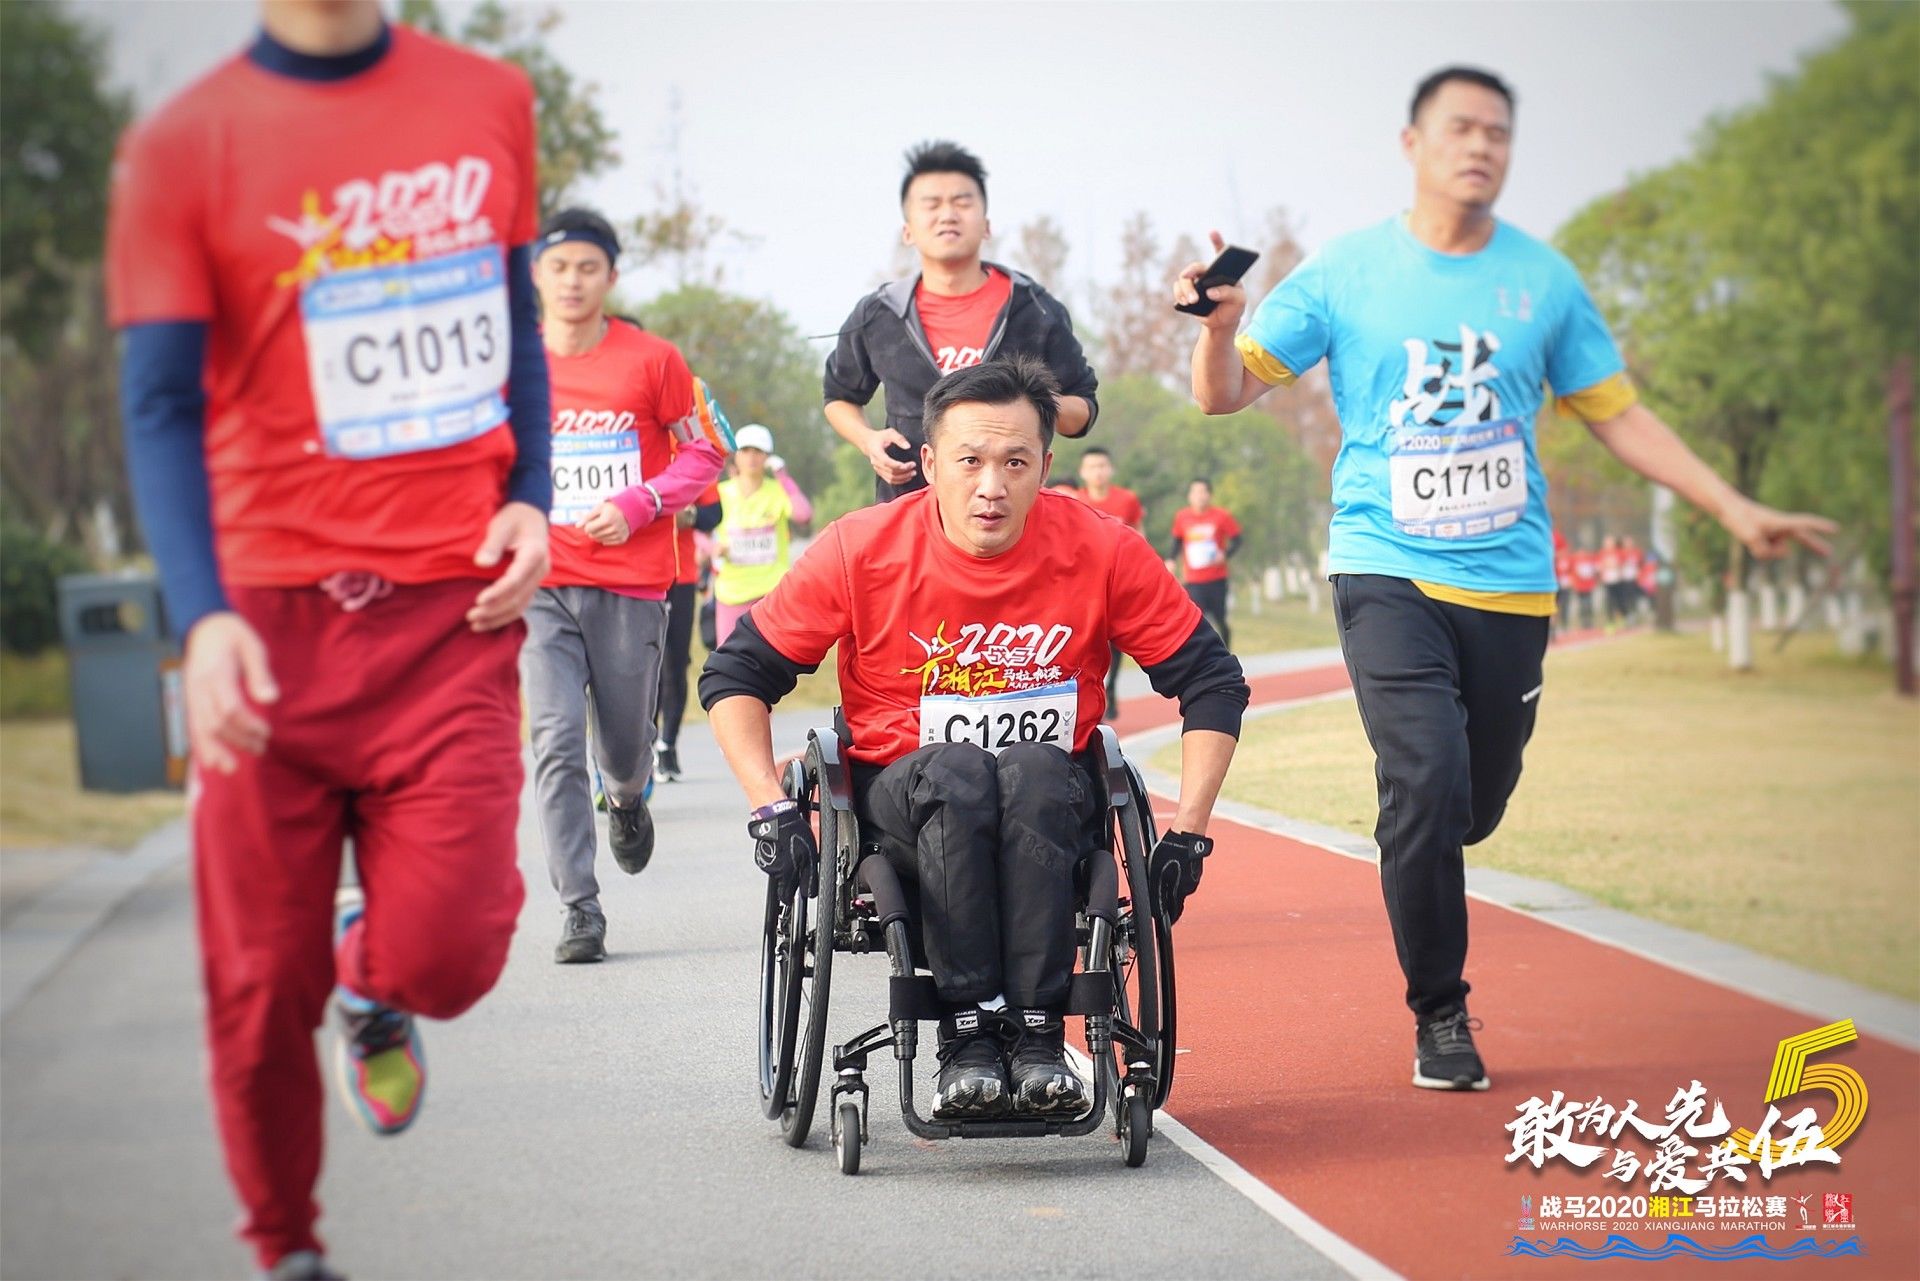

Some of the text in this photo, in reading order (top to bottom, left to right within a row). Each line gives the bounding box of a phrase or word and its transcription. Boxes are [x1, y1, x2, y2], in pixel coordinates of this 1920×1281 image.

[345, 313, 496, 385] C1013
[553, 462, 631, 491] C1011
[1412, 457, 1512, 500] C1718
[956, 622, 1073, 667] 2020
[944, 708, 1060, 749] C1262
